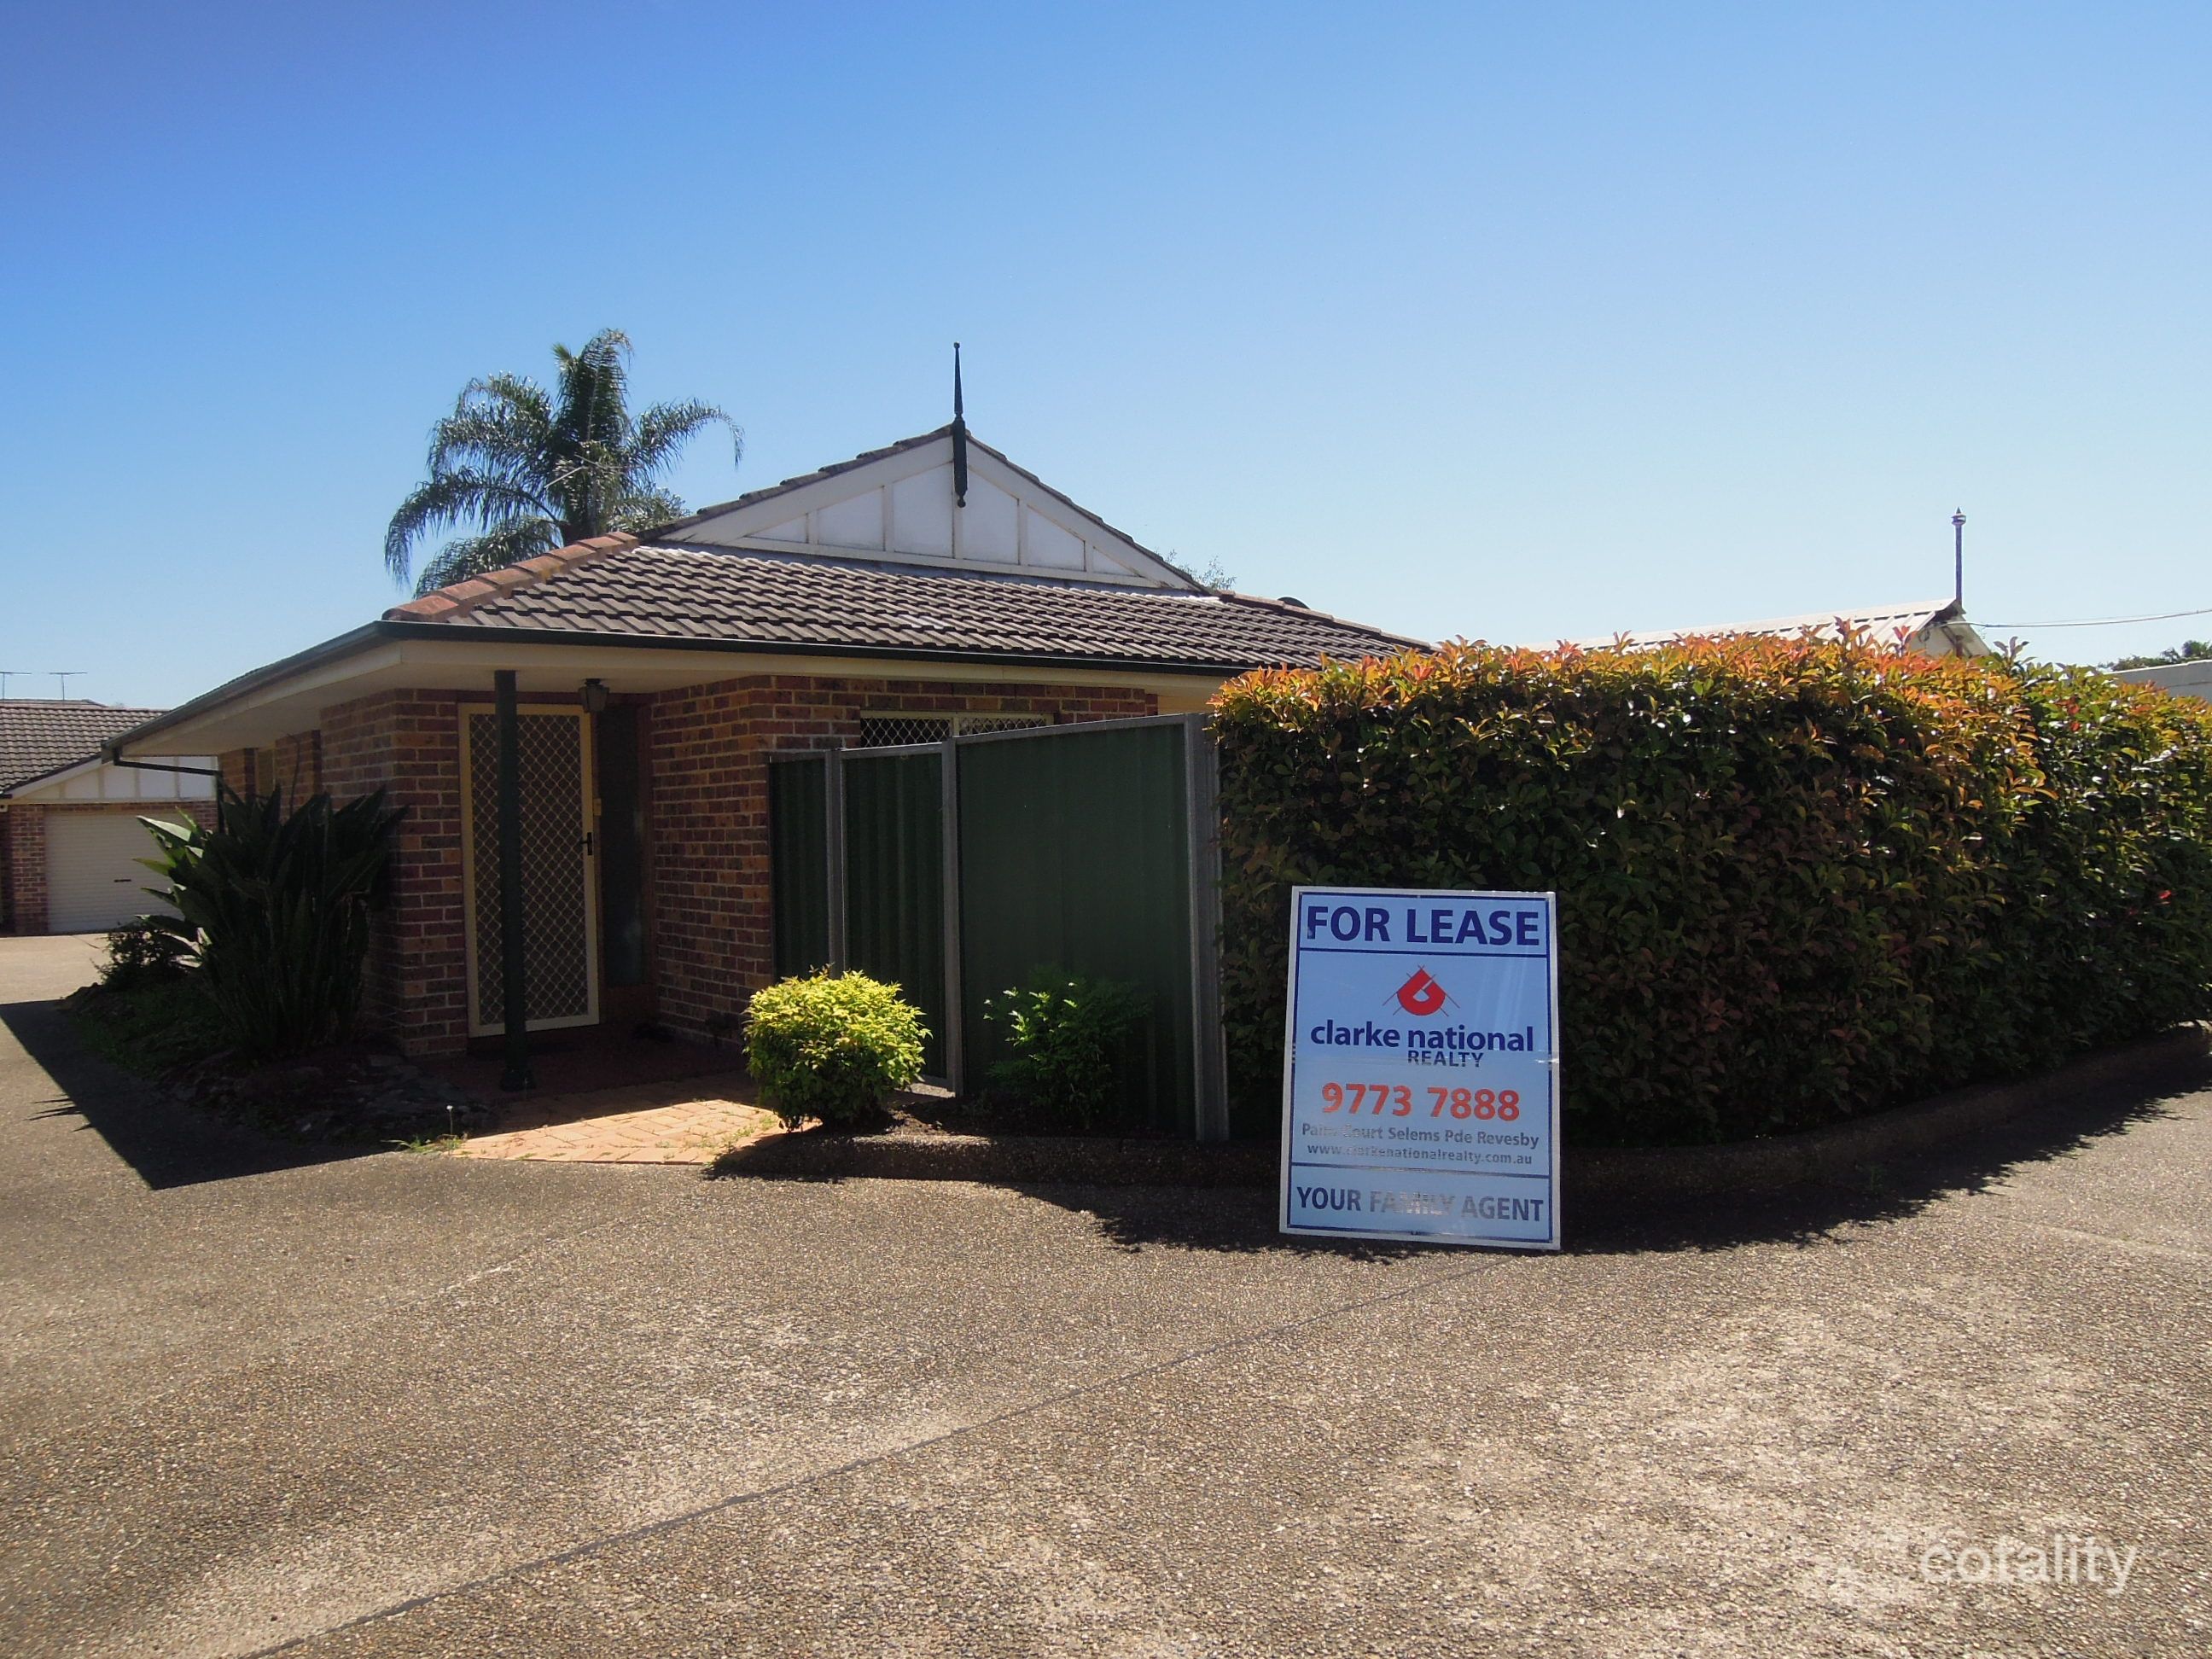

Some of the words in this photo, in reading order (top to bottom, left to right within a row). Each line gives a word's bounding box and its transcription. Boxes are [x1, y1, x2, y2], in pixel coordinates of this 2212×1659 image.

[1307, 905, 1390, 942] FOR
[1406, 909, 1540, 946] LEASE
[1311, 1019, 1400, 1048] clarke
[1408, 1024, 1534, 1051] national
[1408, 1050, 1483, 1068] REALTY
[1322, 1082, 1412, 1117] 9773
[1427, 1086, 1520, 1121] 7888
[1388, 1126, 1440, 1143] Selems
[1445, 1129, 1473, 1144] Pde
[1477, 1131, 1540, 1150] Revesby
[1296, 1186, 1361, 1212] YOUR
[1461, 1195, 1545, 1222] AGENT
